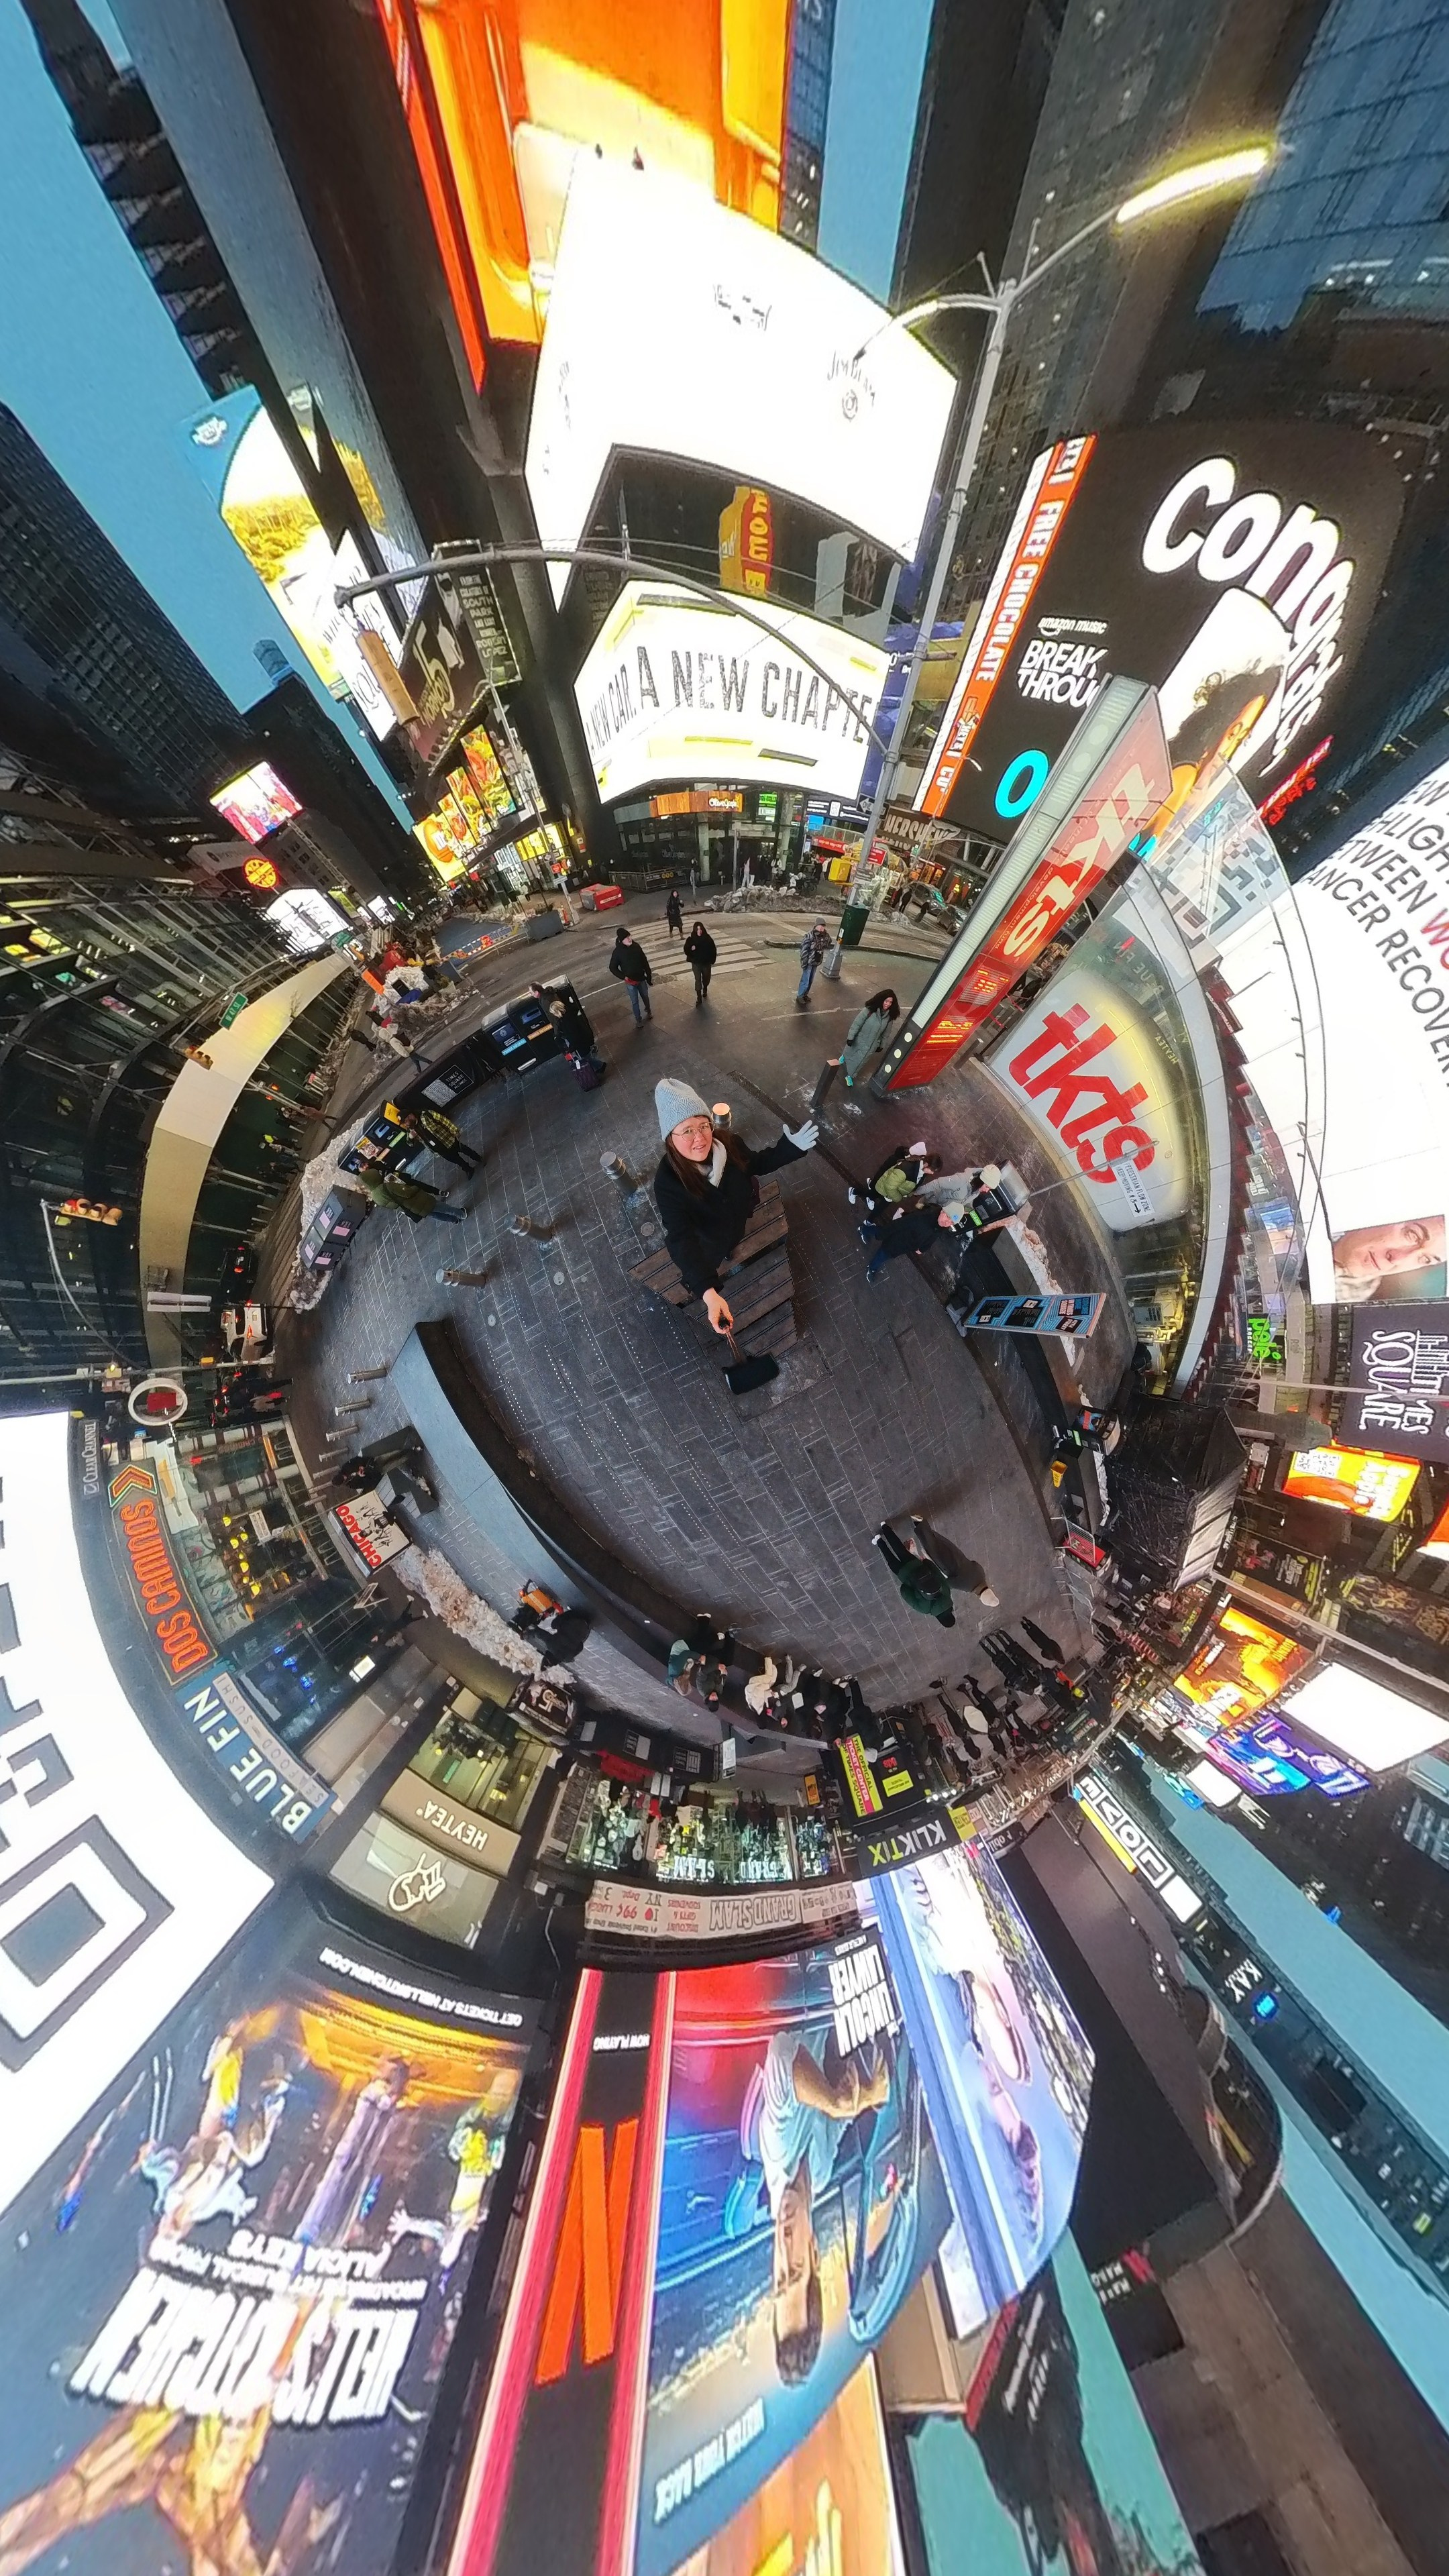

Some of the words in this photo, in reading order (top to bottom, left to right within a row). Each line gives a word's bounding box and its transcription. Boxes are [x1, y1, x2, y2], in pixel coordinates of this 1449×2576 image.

[1022, 499, 1066, 559] FREE
[975, 562, 1040, 682] CHOCOLATE
[1017, 668, 1101, 708] THROU
[1020, 639, 1108, 679] BREAK
[637, 645, 660, 709] A
[671, 649, 750, 713] NEW
[762, 660, 880, 746] CHAPTE
[1003, 763, 1155, 957] tkts
[1007, 865, 1055, 930] development
[994, 928, 1011, 950] fund
[1008, 1002, 1155, 1184] tkts
[1061, 1318, 1073, 1331] STREET
[120, 1500, 181, 1615] CAMINOS
[337, 1505, 382, 1567] CHICAGO
[156, 1609, 209, 1674] DOS
[184, 1686, 241, 1754] FIN
[216, 1676, 254, 1725] SUSHI
[846, 1739, 859, 1767] TICKET
[854, 1767, 869, 1801] CENTER
[853, 1737, 862, 1754] THE
[857, 1754, 874, 1791] OFFICIAL
[229, 1747, 313, 1835] BLUE
[843, 1754, 856, 1780] TIMES
[851, 1780, 867, 1815] SQUARE
[423, 1800, 490, 1852] HEYTEA
[867, 1819, 948, 1867] KLIKTIX
[645, 1892, 661, 1906] NY
[708, 1898, 753, 1931] SLAM
[752, 1894, 796, 1925] GRAND
[828, 1945, 885, 2000] LAWYER
[833, 1982, 893, 2057] LINCOLN
